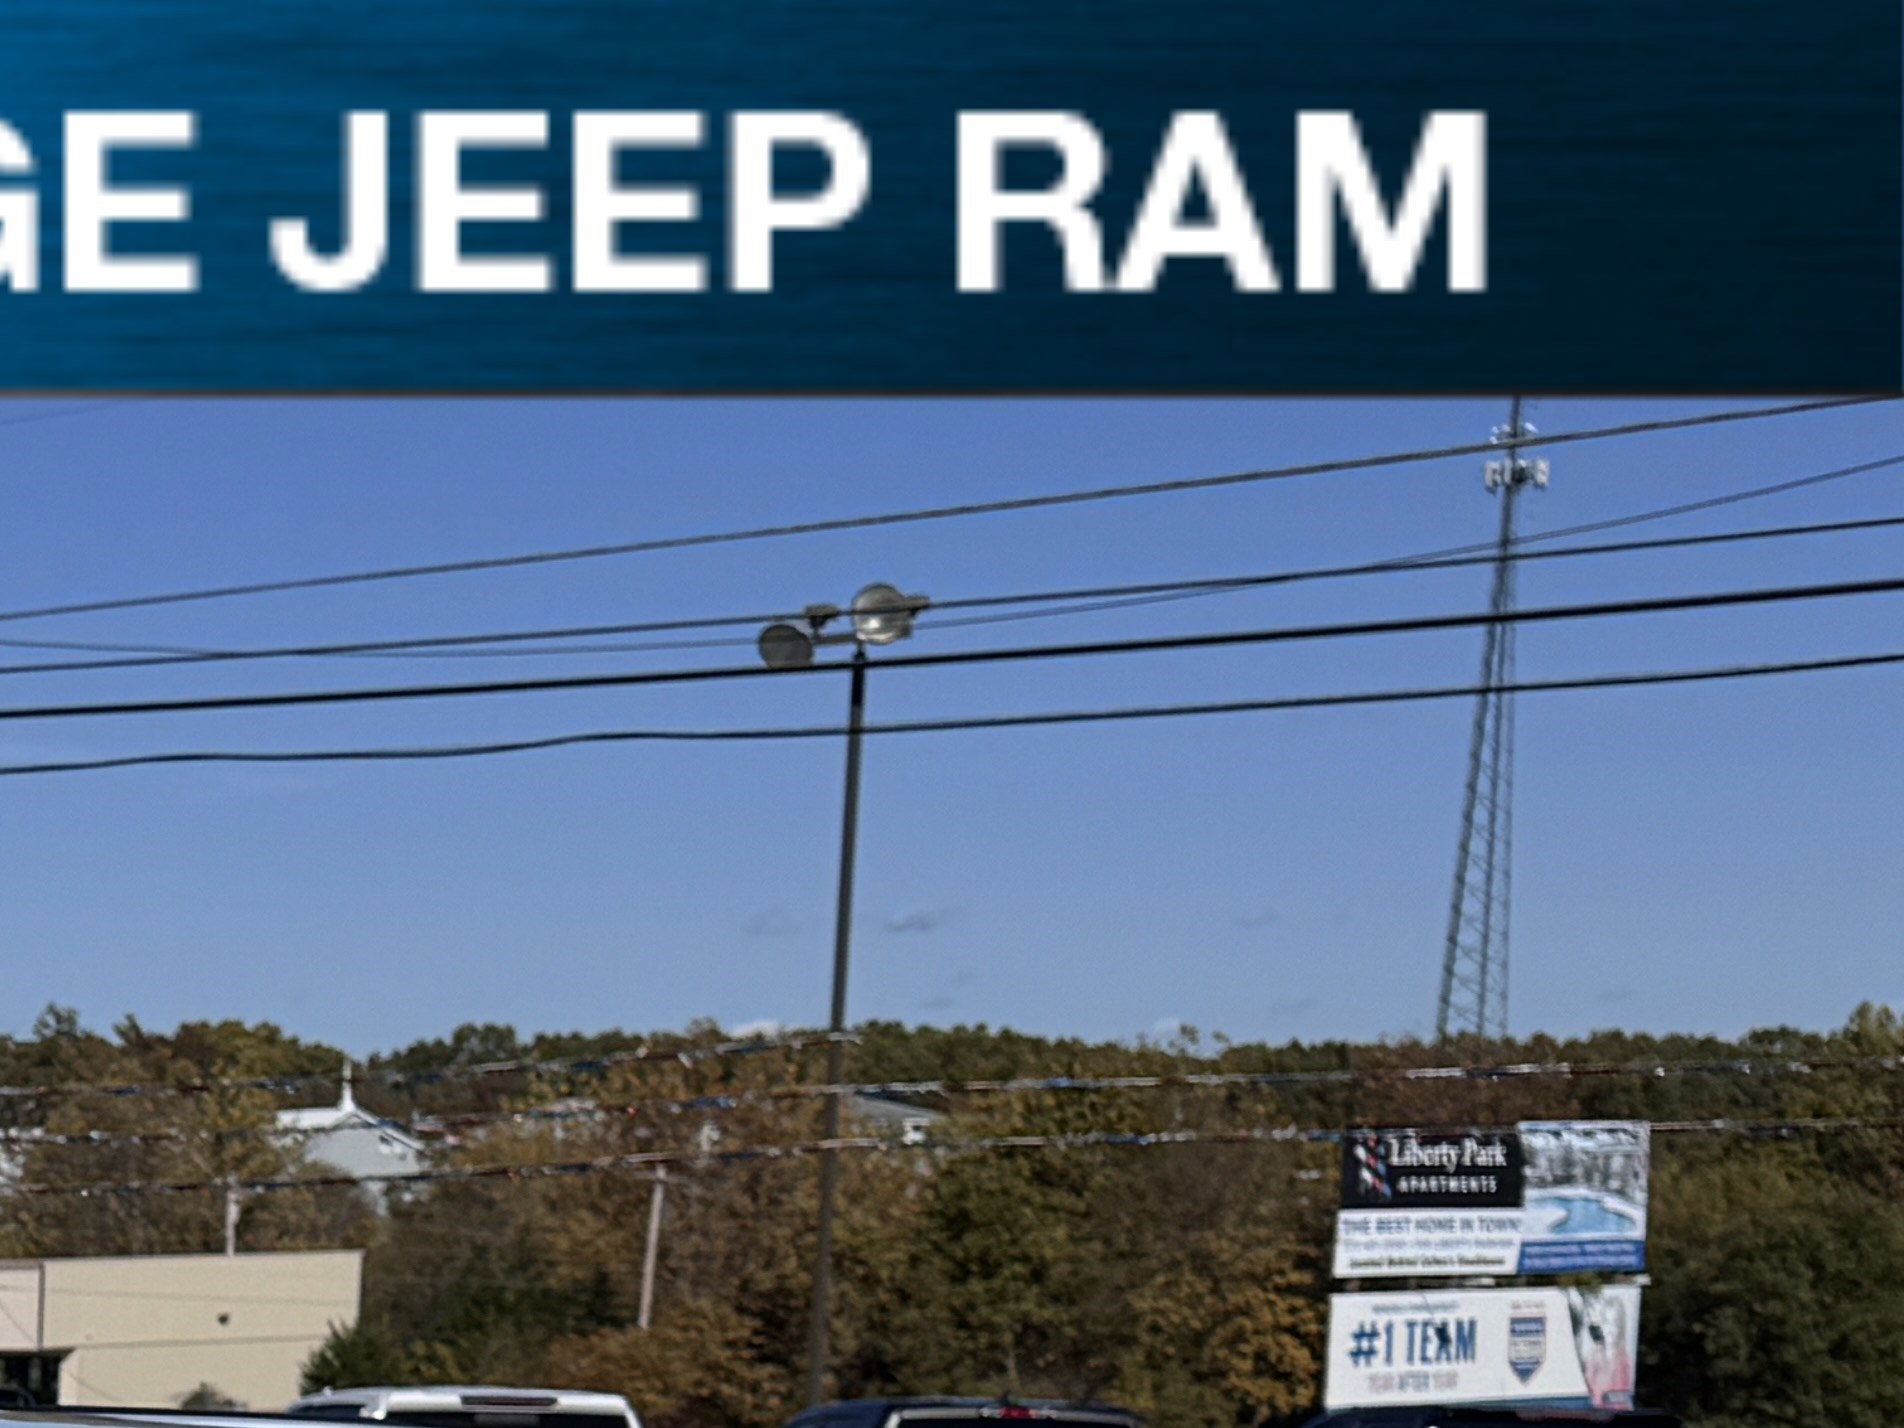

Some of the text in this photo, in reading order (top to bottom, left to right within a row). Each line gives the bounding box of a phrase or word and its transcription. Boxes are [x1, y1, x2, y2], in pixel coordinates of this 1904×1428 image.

[1390, 1133, 1508, 1173] Liberty Park
[1397, 1175, 1498, 1195] APARTMENTS
[1348, 1319, 1395, 1367] #1
[1403, 1317, 1479, 1365] TEAM
